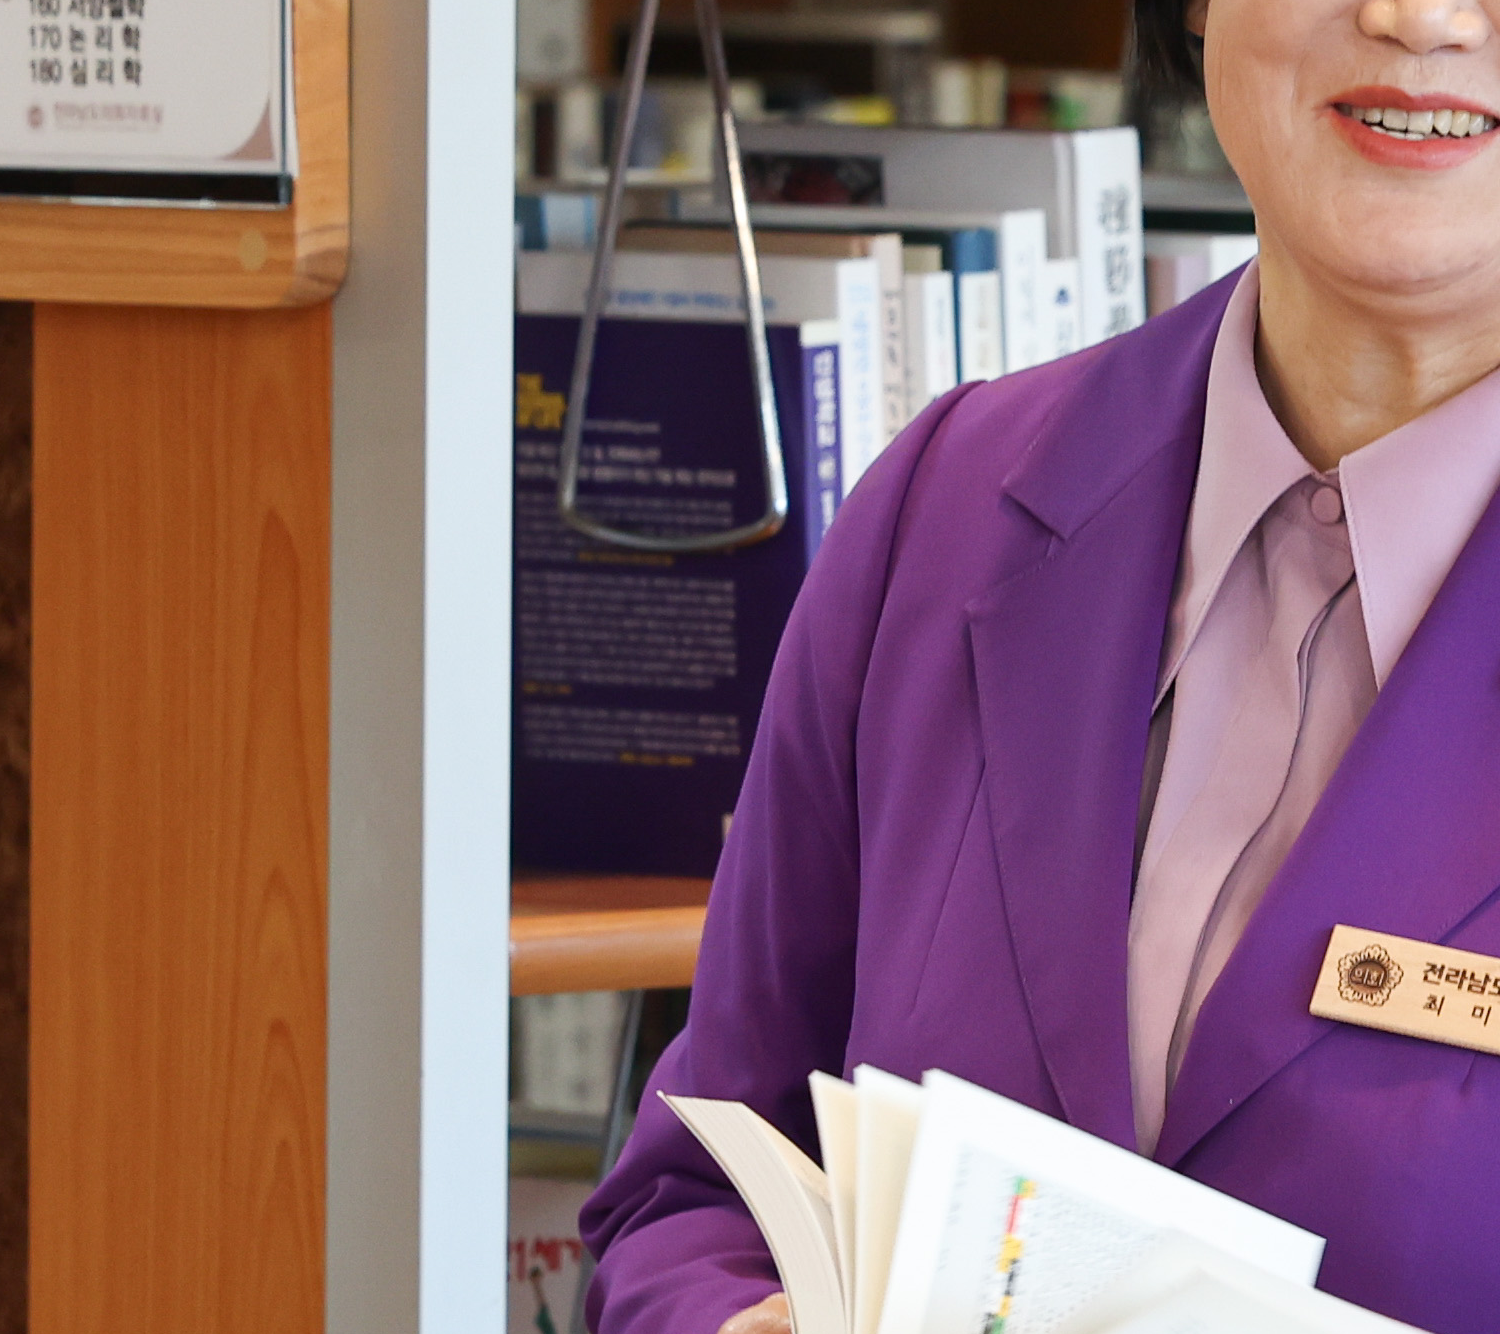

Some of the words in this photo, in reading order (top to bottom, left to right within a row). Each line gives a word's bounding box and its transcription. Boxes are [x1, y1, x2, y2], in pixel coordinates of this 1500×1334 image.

[1350, 967, 1385, 988] 의회
[1423, 994, 1445, 1017] 최
[1471, 1005, 1492, 1027] 미
